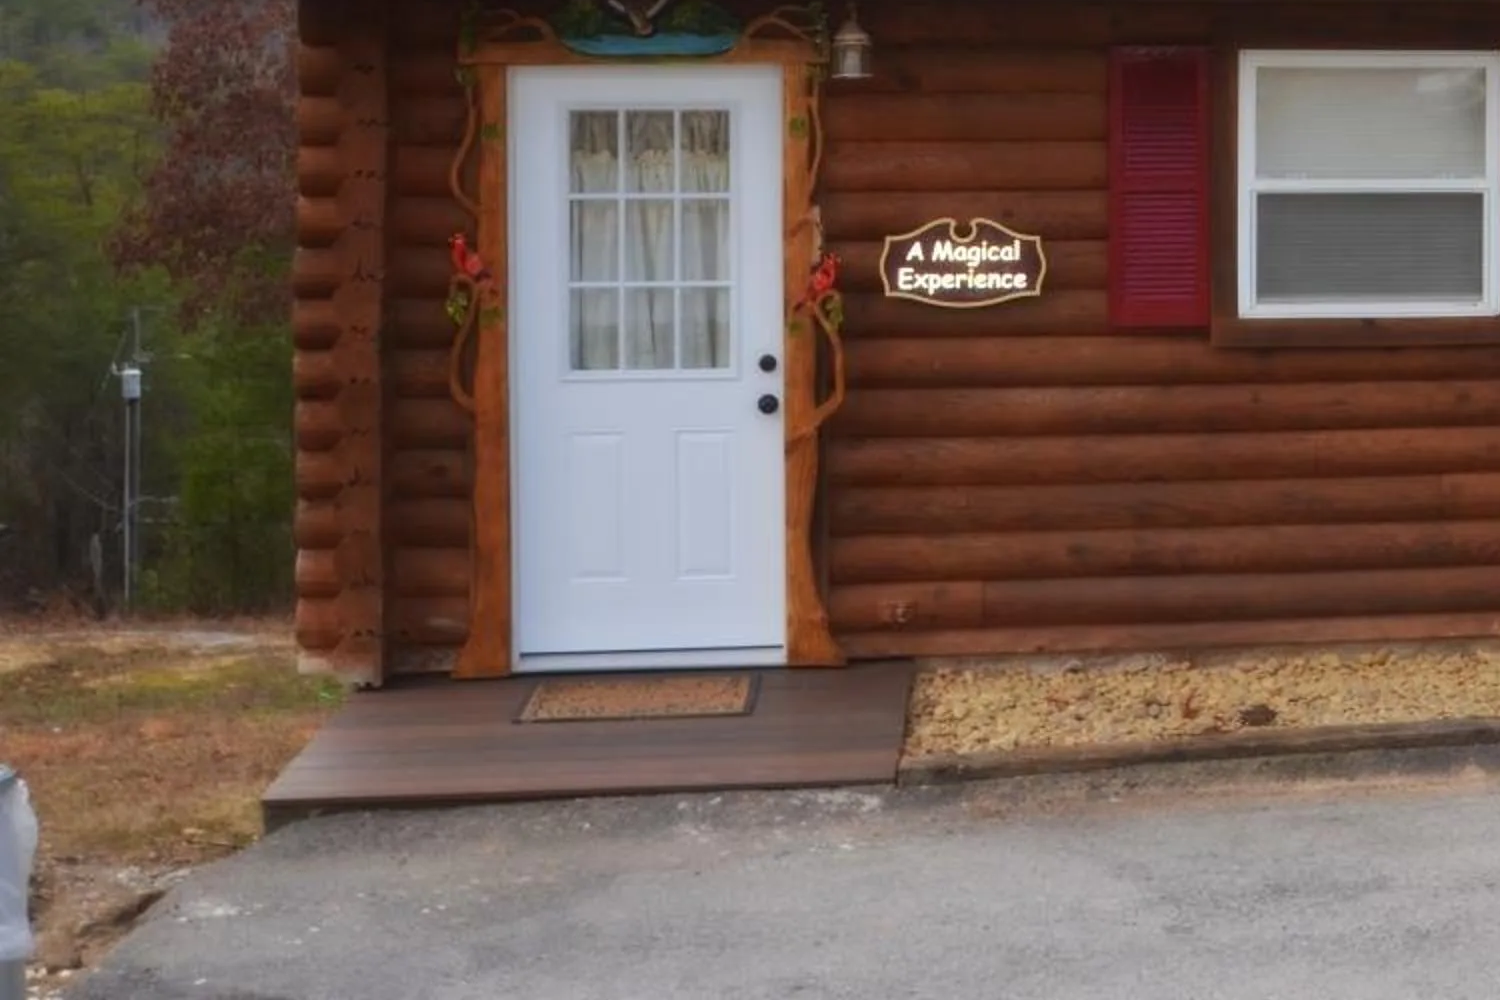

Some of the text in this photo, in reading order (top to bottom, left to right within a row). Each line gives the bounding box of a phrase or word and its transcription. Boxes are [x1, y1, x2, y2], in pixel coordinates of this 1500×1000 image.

[905, 239, 1022, 267] A Magical
[897, 267, 1028, 296] Experience
